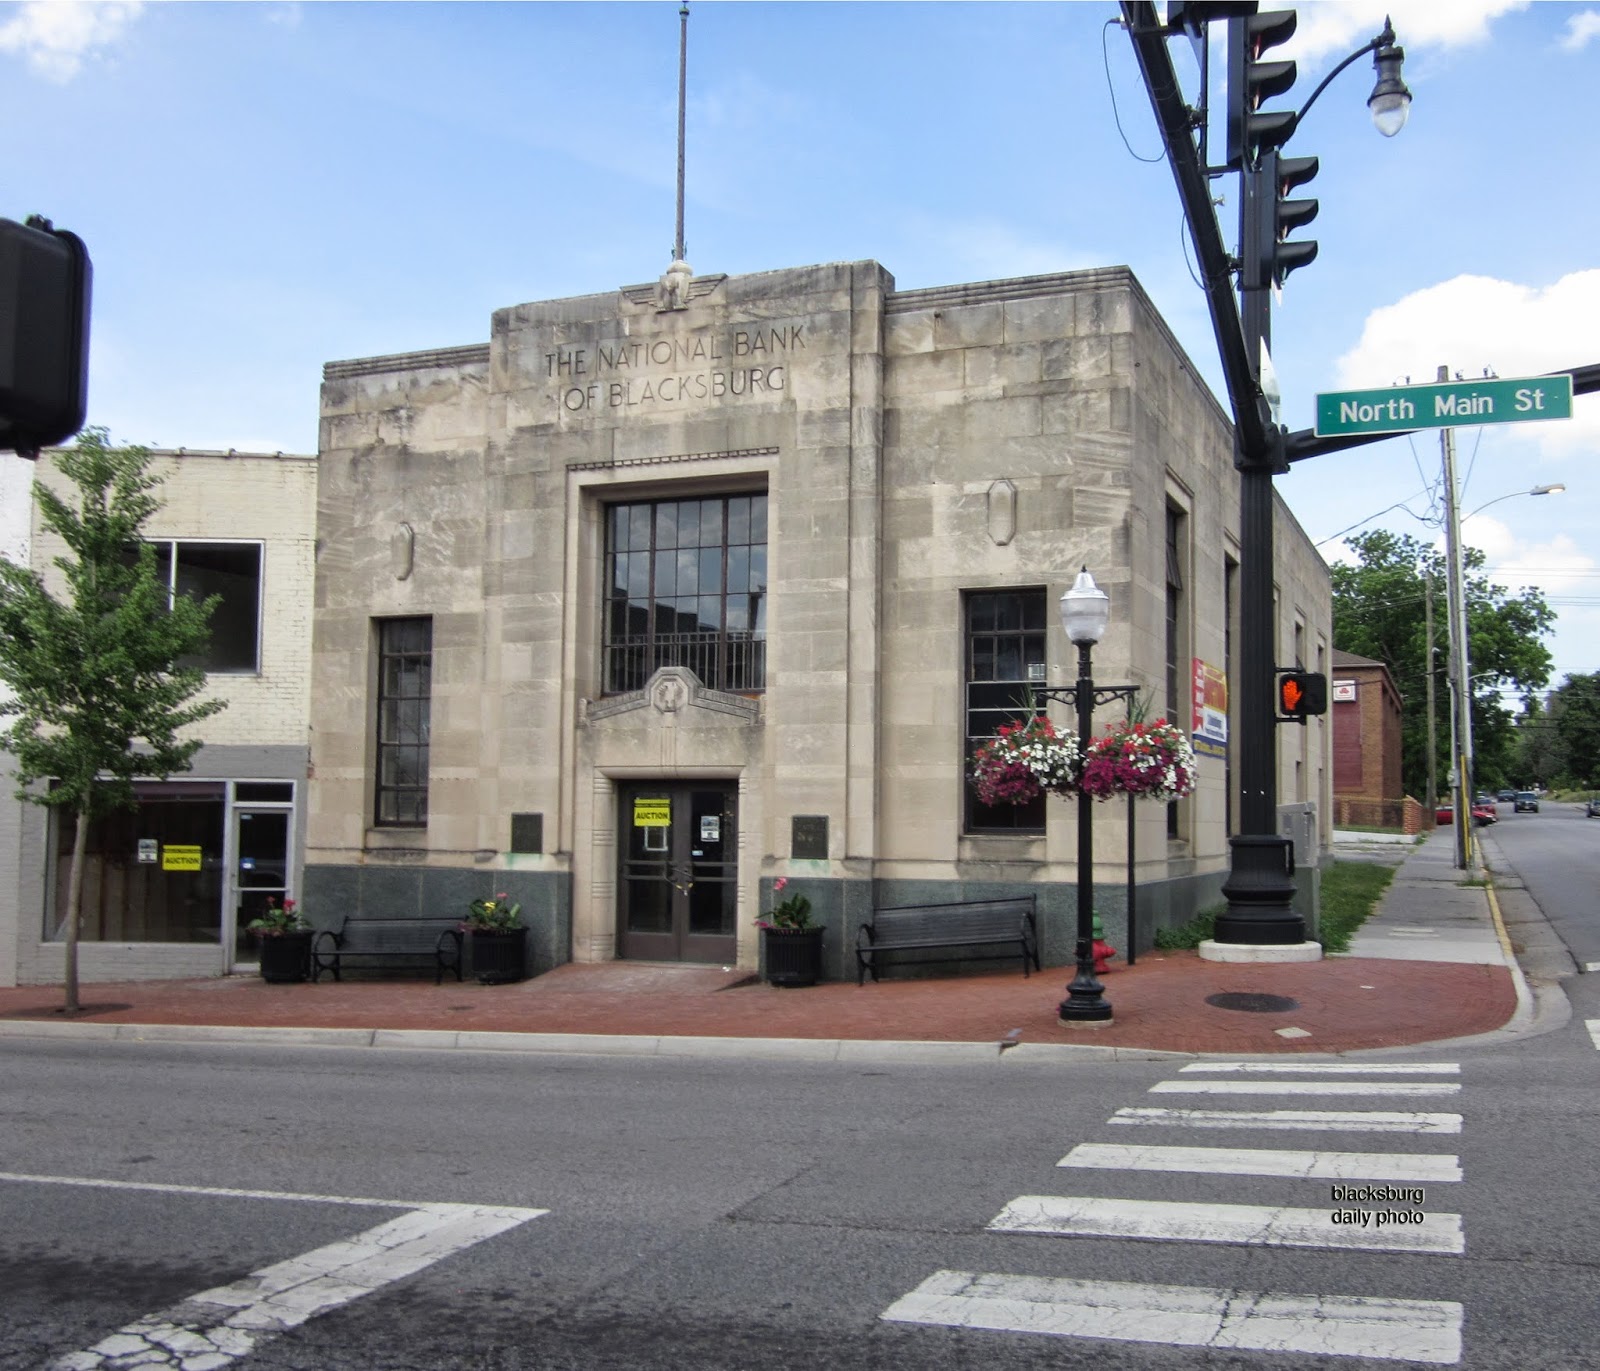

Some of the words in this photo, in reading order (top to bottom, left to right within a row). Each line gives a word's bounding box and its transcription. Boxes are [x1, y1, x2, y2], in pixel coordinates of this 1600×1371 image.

[545, 350, 587, 378] THE
[598, 335, 722, 372] NATIONAL
[734, 325, 806, 357] BANK
[564, 385, 599, 411] OF
[609, 366, 785, 407] BLACKSBURG
[1340, 397, 1415, 424] North
[1434, 392, 1494, 418] Main
[1513, 388, 1545, 411] St
[635, 812, 668, 820] AUCTION
